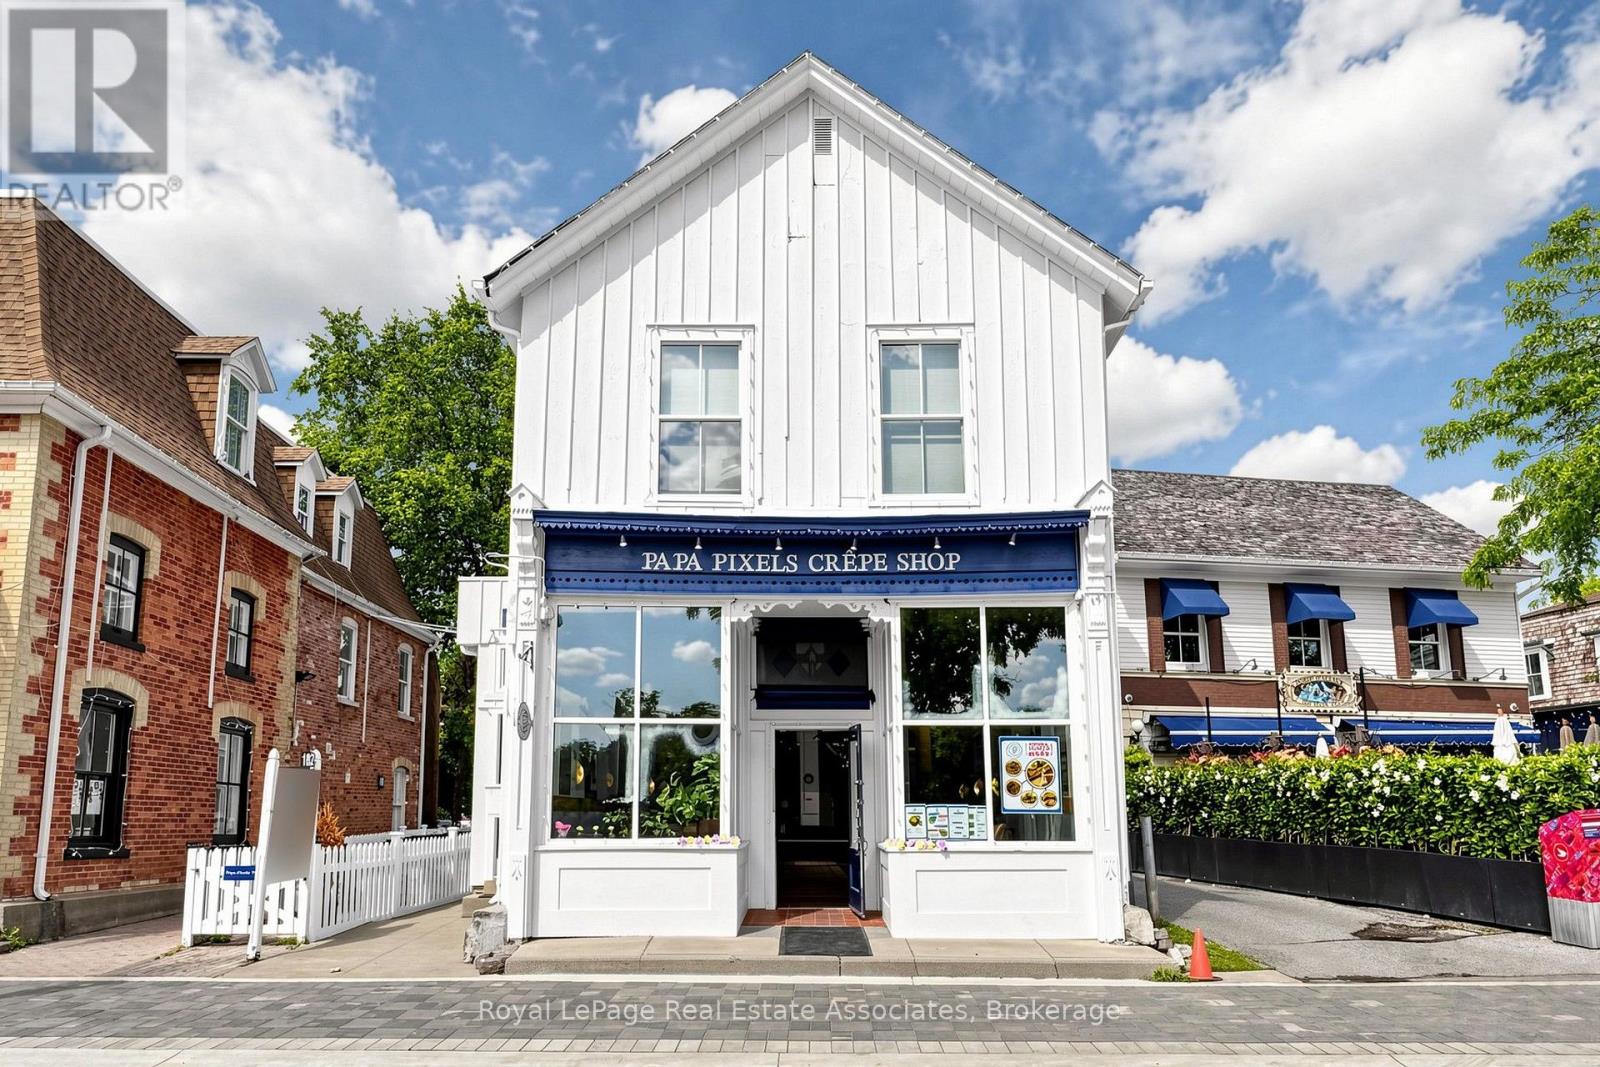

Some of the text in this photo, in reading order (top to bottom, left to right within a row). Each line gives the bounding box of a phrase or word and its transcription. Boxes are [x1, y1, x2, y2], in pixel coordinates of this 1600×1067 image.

[711, 553, 798, 573] PIXELS
[808, 549, 888, 572] CRÊPE
[896, 552, 961, 571] SHOP
